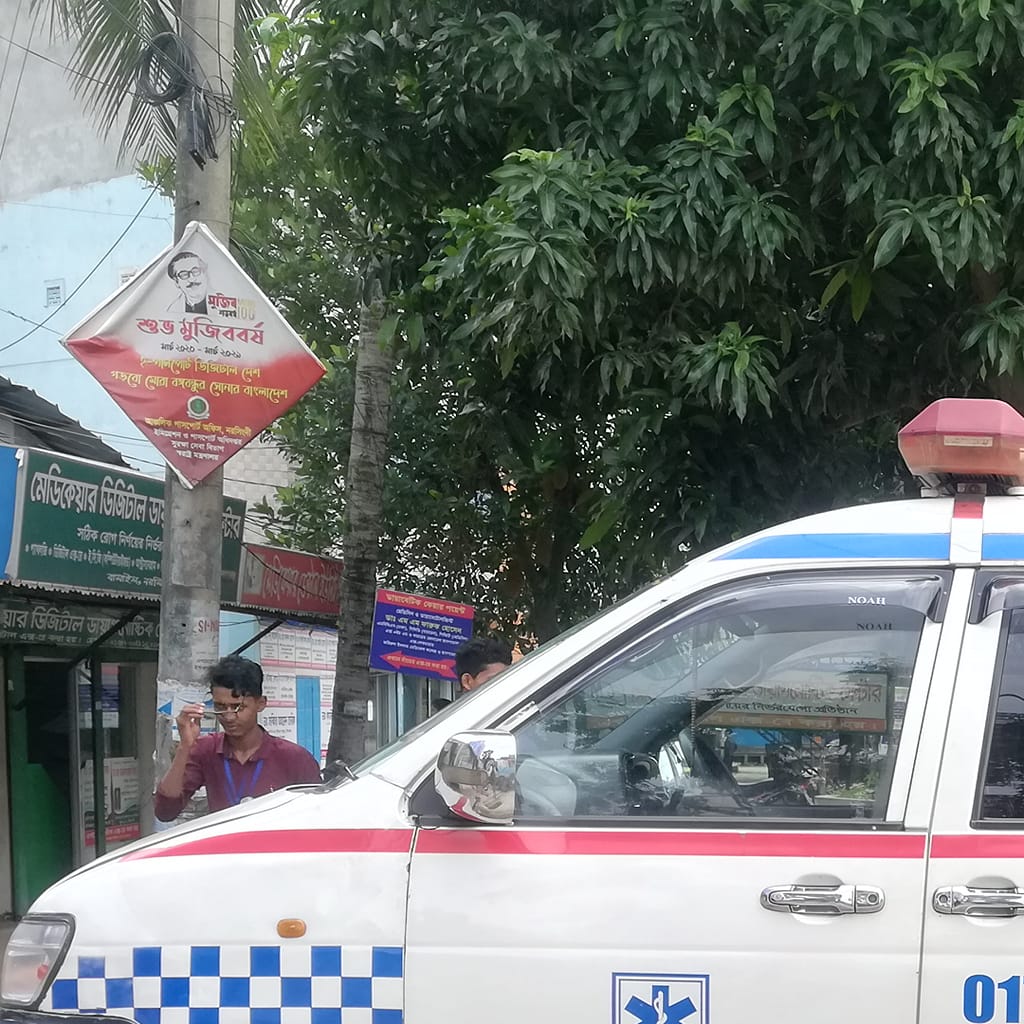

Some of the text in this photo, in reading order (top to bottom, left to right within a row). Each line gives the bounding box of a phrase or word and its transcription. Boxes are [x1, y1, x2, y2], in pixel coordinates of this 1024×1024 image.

[136, 316, 265, 345] শুভ মুজিববর্ষ
[161, 341, 174, 351] মার্চ
[241, 367, 261, 382] দেশ
[145, 376, 169, 391] মোরা
[209, 382, 240, 397] সোনার
[243, 386, 288, 404] বাংলাদেশ
[30, 463, 99, 513] মেডিকেয়ার
[99, 475, 147, 523] ডিজিটাল
[77, 524, 98, 542] সঠিক
[100, 529, 117, 545] রোগ
[847, 596, 886, 606] NOAH
[2, 609, 29, 629] য়ার
[31, 606, 85, 633] ডিজিটাল
[856, 622, 893, 631] NOAH
